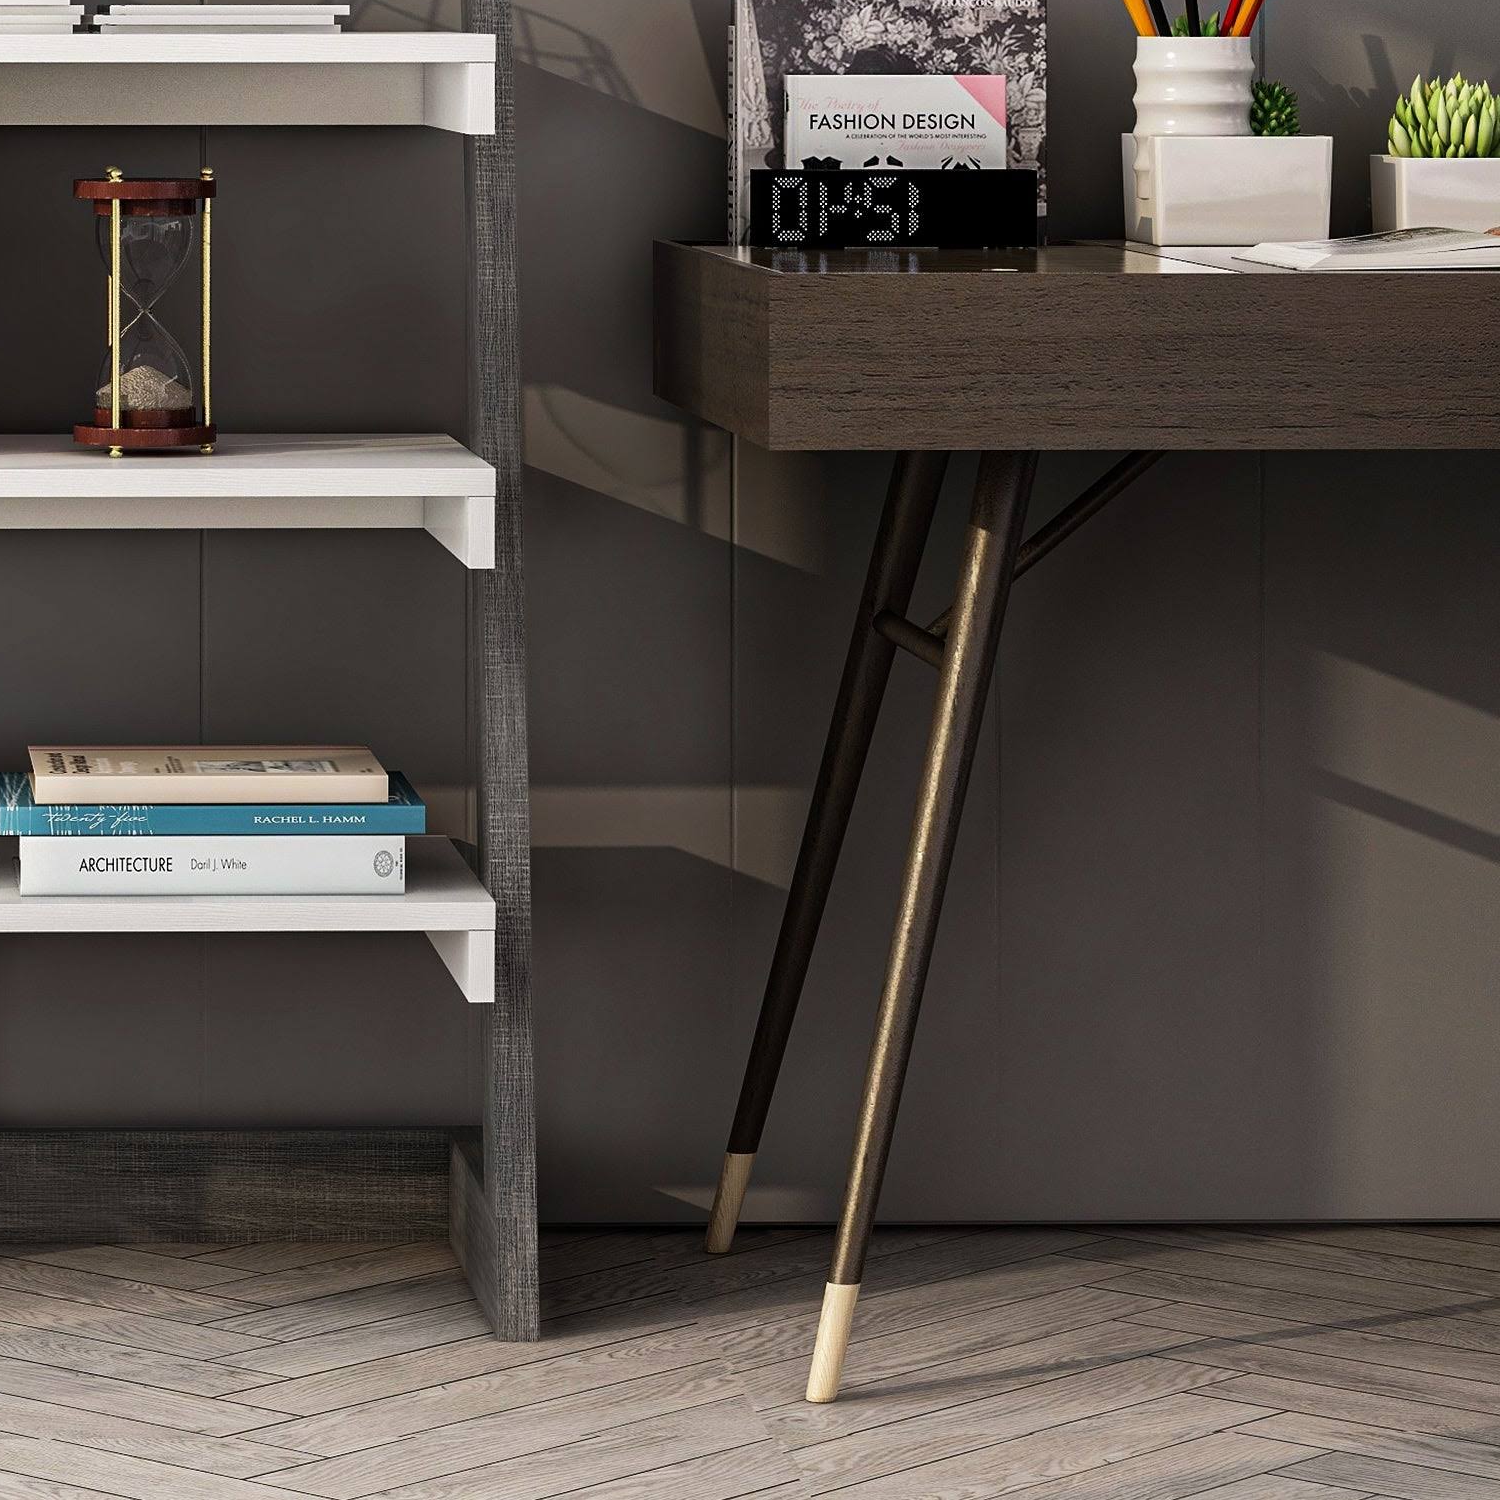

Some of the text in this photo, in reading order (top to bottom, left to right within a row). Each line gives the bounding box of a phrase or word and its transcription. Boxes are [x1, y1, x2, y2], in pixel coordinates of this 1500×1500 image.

[809, 113, 975, 130] FASHION DESIGN
[41, 811, 148, 830] twenty-five
[254, 815, 366, 824] RACHEL L. HAMM
[78, 856, 173, 873] ARCHITECTURE
[220, 857, 248, 871] White
